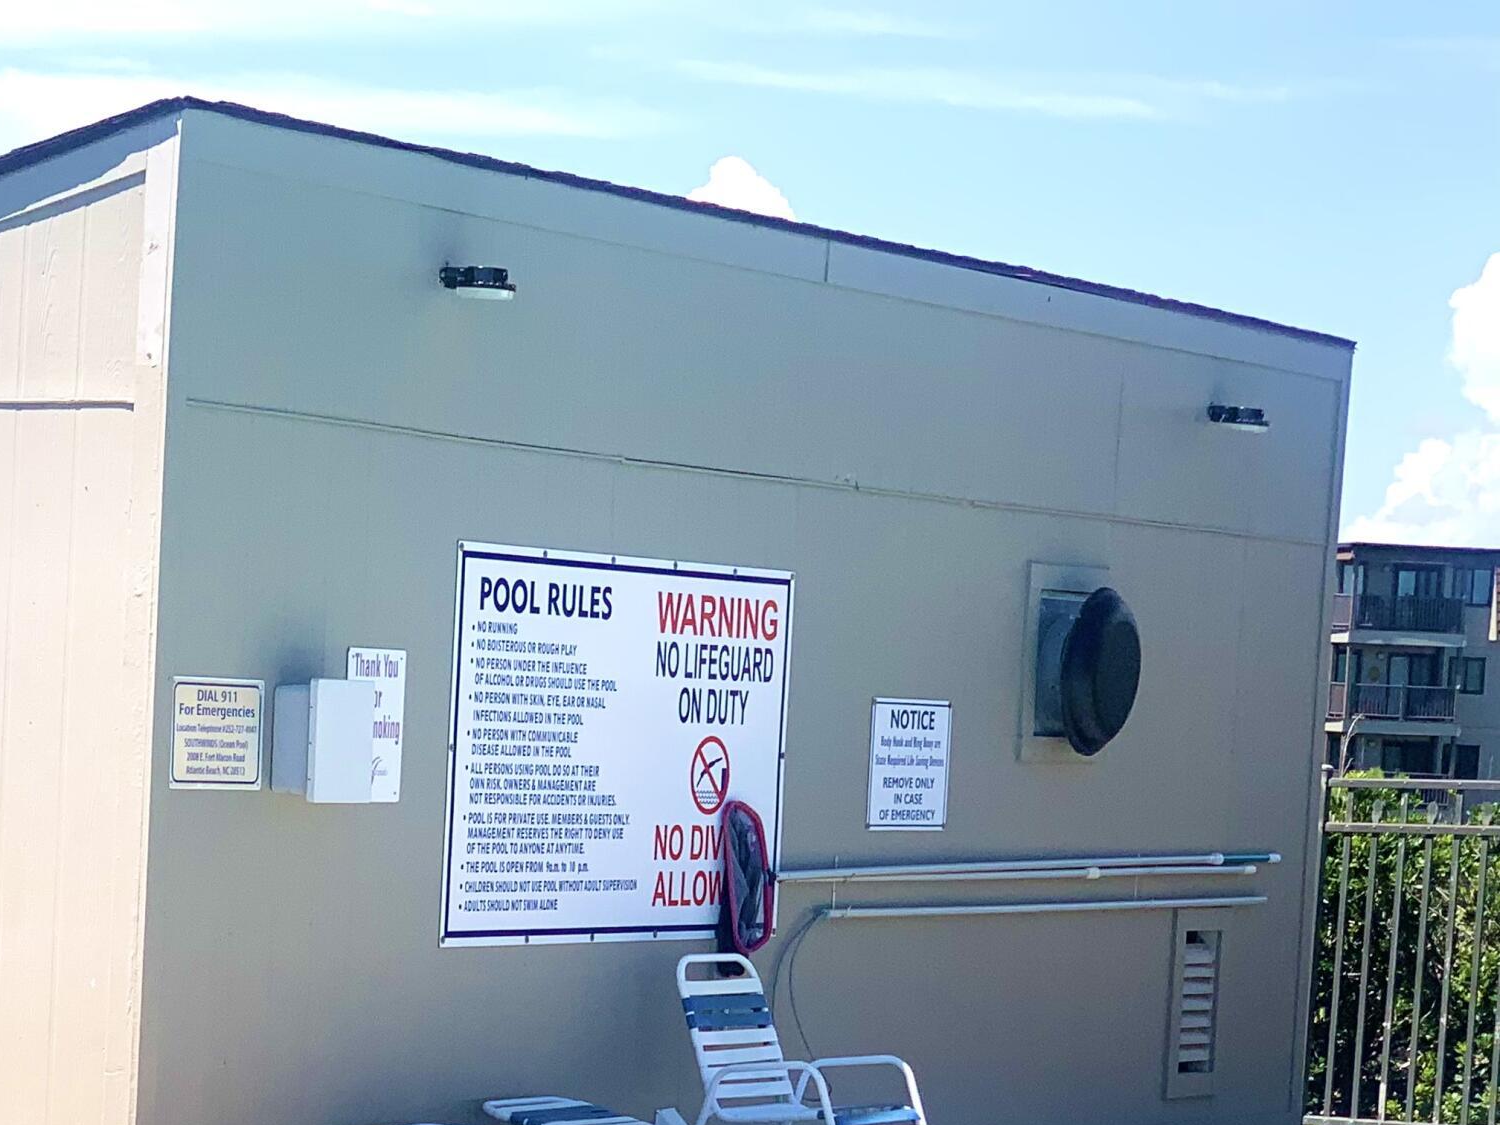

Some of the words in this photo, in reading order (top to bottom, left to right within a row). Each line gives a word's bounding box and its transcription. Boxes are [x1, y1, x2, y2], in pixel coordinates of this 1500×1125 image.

[479, 577, 540, 614] POOL
[548, 582, 613, 620] RULES
[658, 591, 778, 641] WARNING
[478, 621, 486, 632] NO
[488, 622, 518, 635] RUNNING
[477, 639, 486, 650] NO
[487, 640, 526, 653] BOISTEROUS
[528, 642, 536, 653] OR
[538, 643, 559, 655] ROUGH
[561, 644, 577, 656] PLAY
[355, 653, 381, 677] Thank
[384, 654, 399, 678] You
[475, 658, 485, 669] NO
[486, 658, 512, 671] PERSON
[513, 660, 536, 672] UNDER
[538, 661, 550, 672] THE
[552, 662, 587, 675] INFLUENCE
[656, 641, 680, 678] NO
[684, 643, 774, 683] LIFEGUARD
[475, 673, 484, 685] OF
[485, 674, 514, 686] ALCOHOL
[515, 675, 524, 687] OR
[526, 676, 547, 688] DRUGS
[548, 677, 572, 689] SHOULD
[574, 678, 586, 690] USE
[587, 679, 600, 691] THE
[602, 680, 617, 691] POOL
[197, 690, 218, 702] DIAL
[221, 691, 237, 703] 911
[474, 692, 483, 703] NO
[485, 692, 510, 704] PERSON
[512, 693, 528, 705] WITH
[563, 696, 575, 707] EAR
[577, 697, 585, 708] OR
[586, 697, 606, 709] NASAL
[179, 703, 195, 715] For
[197, 703, 255, 720] Emergencies
[678, 687, 702, 723] ON
[706, 689, 749, 725] DUTY
[473, 710, 511, 722] INFECTIONS
[513, 711, 543, 724] ALLOWED
[545, 713, 551, 724] IN
[553, 713, 566, 725] THE
[567, 714, 583, 725] POOL
[890, 709, 936, 730] NOTICE
[472, 728, 481, 740] NO
[483, 729, 508, 741] PERSON
[510, 730, 527, 741] WITH
[528, 730, 578, 743] COMMUNICABLE
[471, 744, 499, 756] DISEASE
[501, 745, 531, 757] ALLOWED
[533, 746, 540, 757] IN
[541, 746, 554, 757] THE
[555, 747, 572, 758] POOL
[470, 763, 483, 774] ALL
[484, 763, 513, 775] PERSONS
[515, 764, 533, 775] USING
[535, 765, 551, 776] POOL
[552, 765, 561, 776] DO
[563, 765, 570, 776] SO
[571, 766, 579, 776] AT
[580, 766, 600, 777] THEIR
[470, 778, 485, 789] OWN
[504, 779, 531, 790] OWNERS
[532, 780, 535, 791] &
[537, 780, 583, 791] MANAGEMENT
[584, 780, 596, 791] ARE
[883, 777, 913, 788] REMOVE
[915, 777, 935, 788] ONLY
[469, 793, 483, 804] NOT
[484, 793, 528, 805] RESPONSIBLE
[529, 794, 541, 805] FOR
[542, 795, 576, 806] ACCIDENTS
[578, 795, 586, 806] OR
[588, 795, 616, 806] INJURIES.
[894, 794, 902, 804] IN
[904, 794, 923, 804] CASE
[468, 813, 485, 824] POOL
[487, 813, 492, 824] IS
[494, 813, 506, 825] FOR
[508, 813, 535, 825] PRIVATE
[552, 814, 582, 825] MEMBERS
[584, 814, 588, 825] &
[589, 814, 612, 825] GUESTS
[879, 810, 890, 820] OF
[891, 810, 935, 820] EMERGENCY
[467, 828, 515, 839] MANAGEMENT
[517, 828, 549, 839] RESERVES
[550, 828, 563, 839] THE
[564, 828, 583, 839] RIGHT
[585, 828, 592, 839] TO
[594, 828, 611, 839] DENY
[612, 828, 624, 839] USE
[467, 843, 476, 854] OF
[478, 843, 490, 854] THE
[492, 843, 508, 854] POOL
[510, 843, 518, 854] TO
[519, 843, 545, 854] ANYONE
[546, 843, 554, 854] AT
[555, 843, 585, 854] ANYTIME.
[653, 825, 684, 860] NO
[690, 825, 725, 860] DIV
[466, 862, 479, 872] THE
[481, 862, 498, 872] POOL
[499, 862, 505, 872] IS
[506, 862, 523, 872] OPEN
[525, 862, 543, 872] FROM
[561, 862, 567, 872] to
[570, 862, 575, 872] 10
[465, 881, 494, 893] CHILDREN
[495, 881, 518, 892] SHOULD
[519, 881, 530, 892] NOT
[532, 881, 542, 892] USE
[543, 880, 557, 892] POOL
[559, 880, 583, 892] WITHOUT
[584, 880, 601, 891] ADULT
[602, 880, 637, 891] SUPERVISION
[652, 870, 724, 907] ALLOW
[464, 900, 486, 911] ADULTS
[487, 900, 510, 911] SHOULD
[511, 900, 522, 910] NOT
[523, 900, 538, 910] SWIM
[539, 899, 558, 910] ALONE
